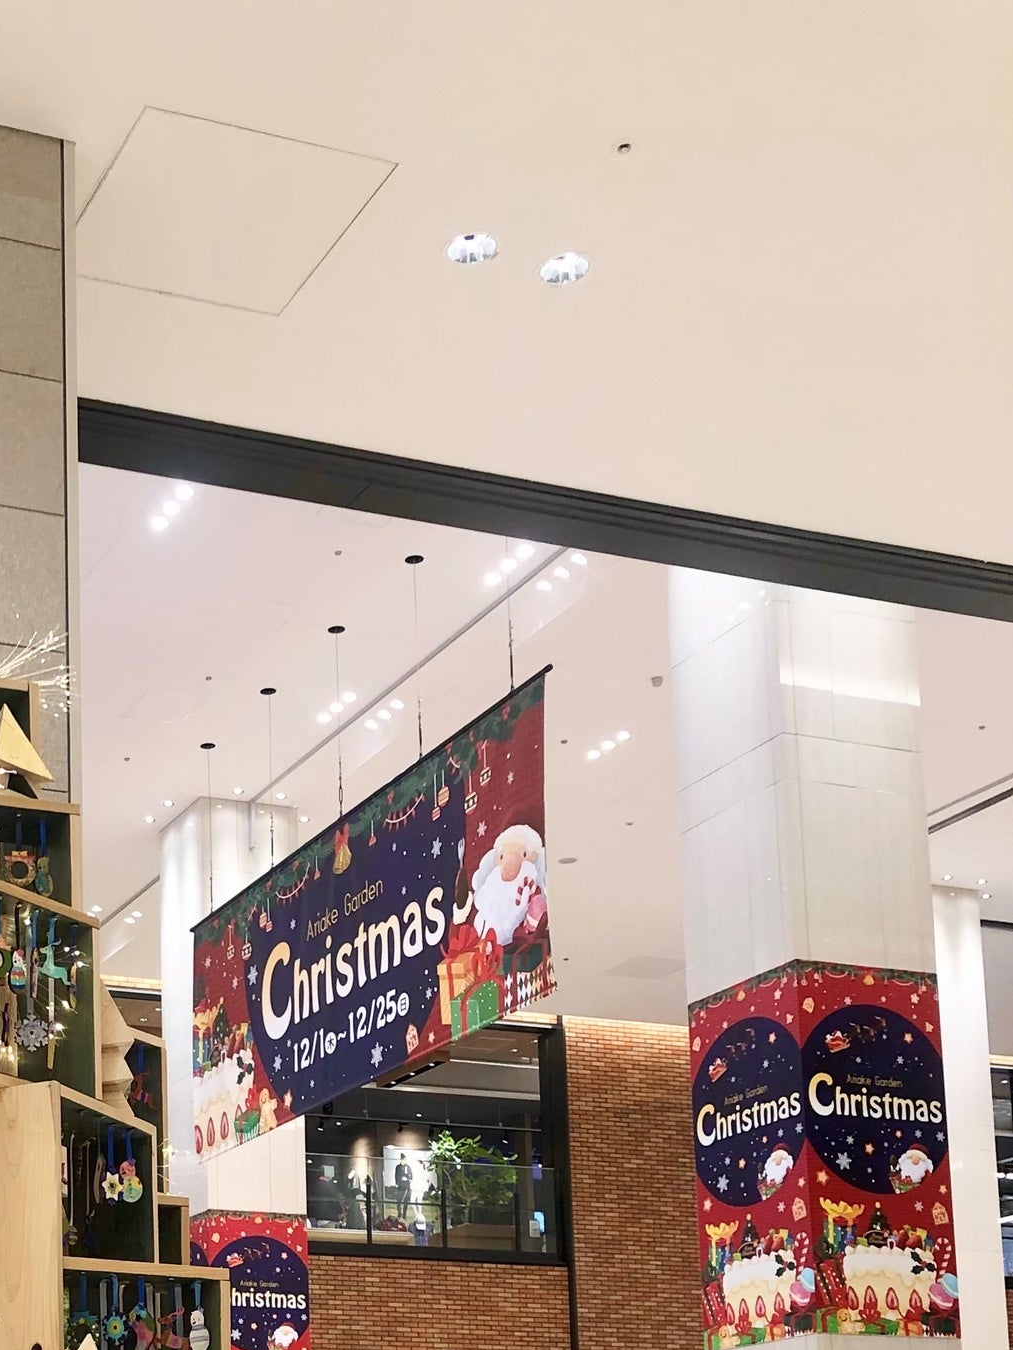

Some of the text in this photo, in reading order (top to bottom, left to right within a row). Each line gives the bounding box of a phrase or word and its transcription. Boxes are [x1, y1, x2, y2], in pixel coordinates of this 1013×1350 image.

[306, 879, 384, 941] Ariake Garden
[261, 886, 447, 1040] Christmas
[696, 1092, 801, 1147] Christmas
[808, 1072, 943, 1124] Christmas
[231, 1287, 307, 1310] hristmas
